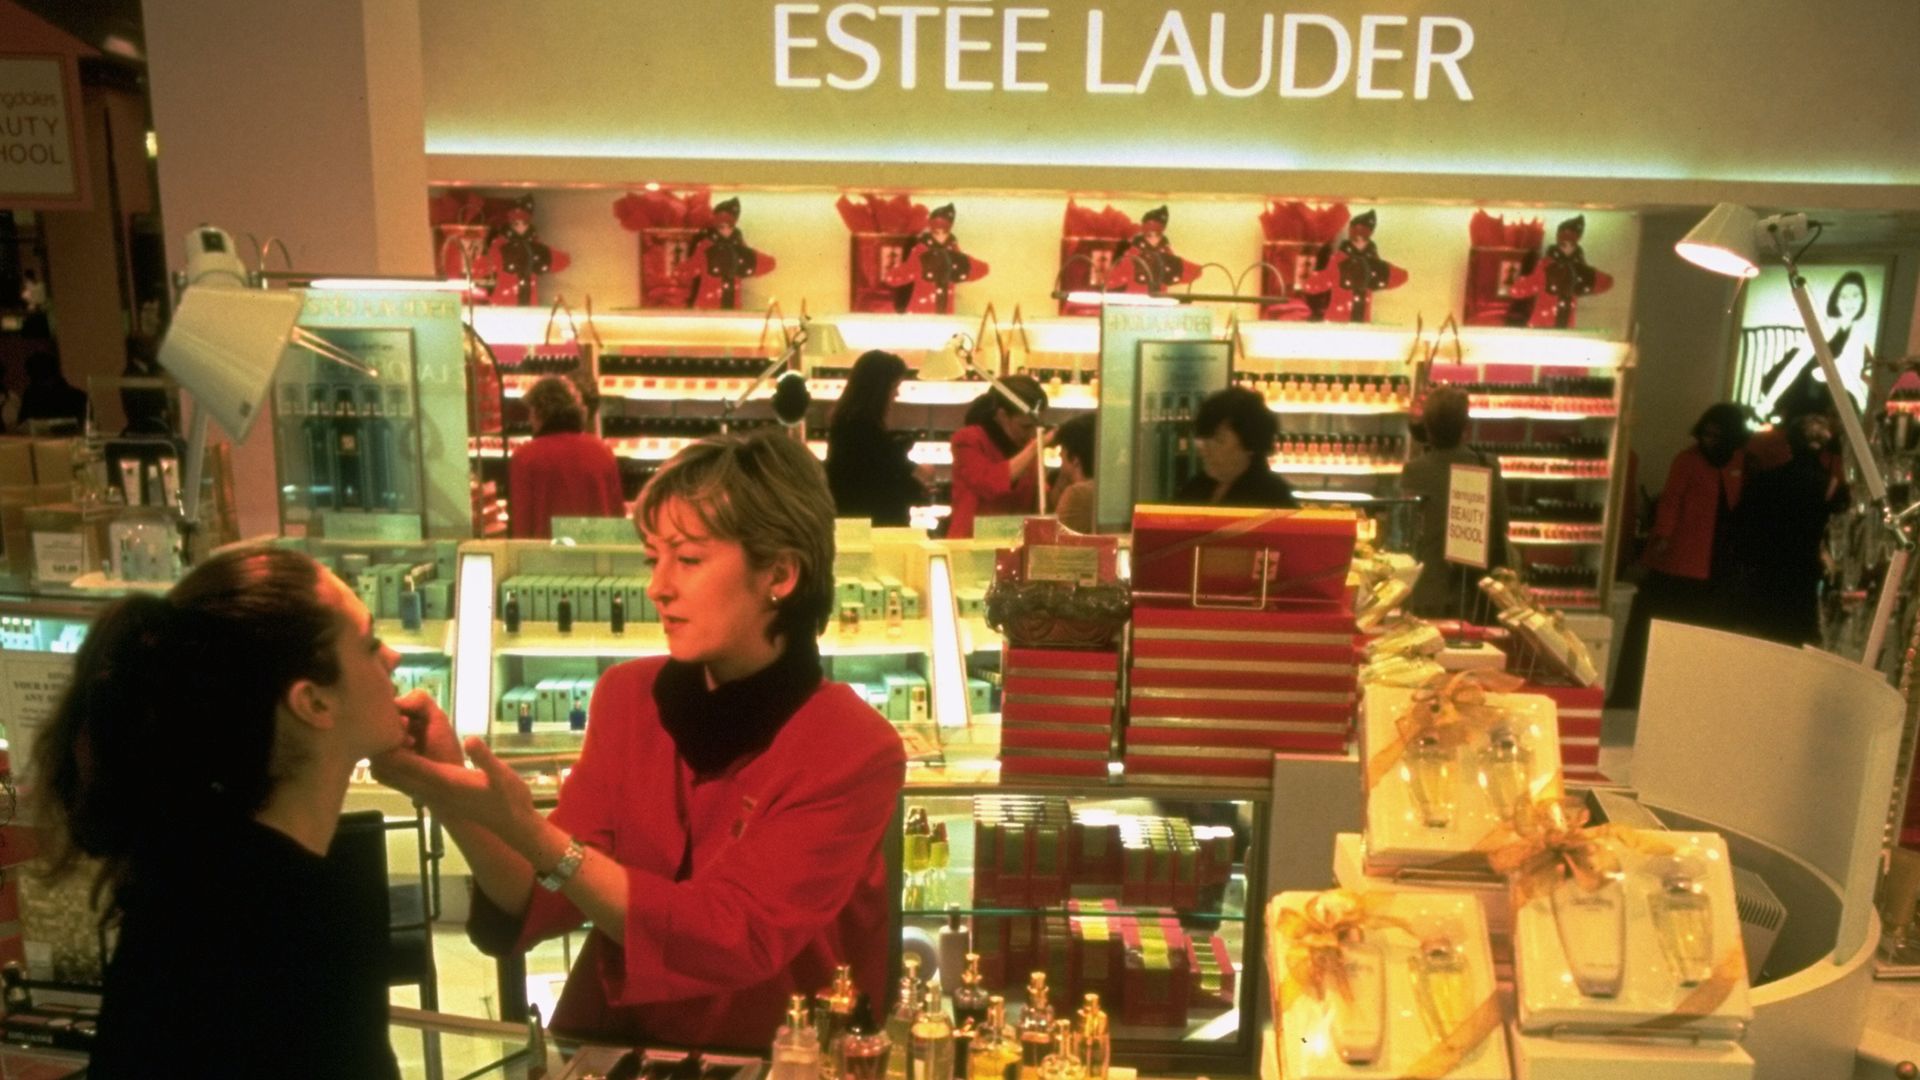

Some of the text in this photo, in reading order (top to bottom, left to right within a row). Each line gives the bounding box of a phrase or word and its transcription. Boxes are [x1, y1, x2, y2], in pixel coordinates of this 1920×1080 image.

[1086, 9, 1474, 100] LAUDER
[1450, 505, 1485, 524] BEAUTY
[1448, 523, 1483, 544] SCHOOL
